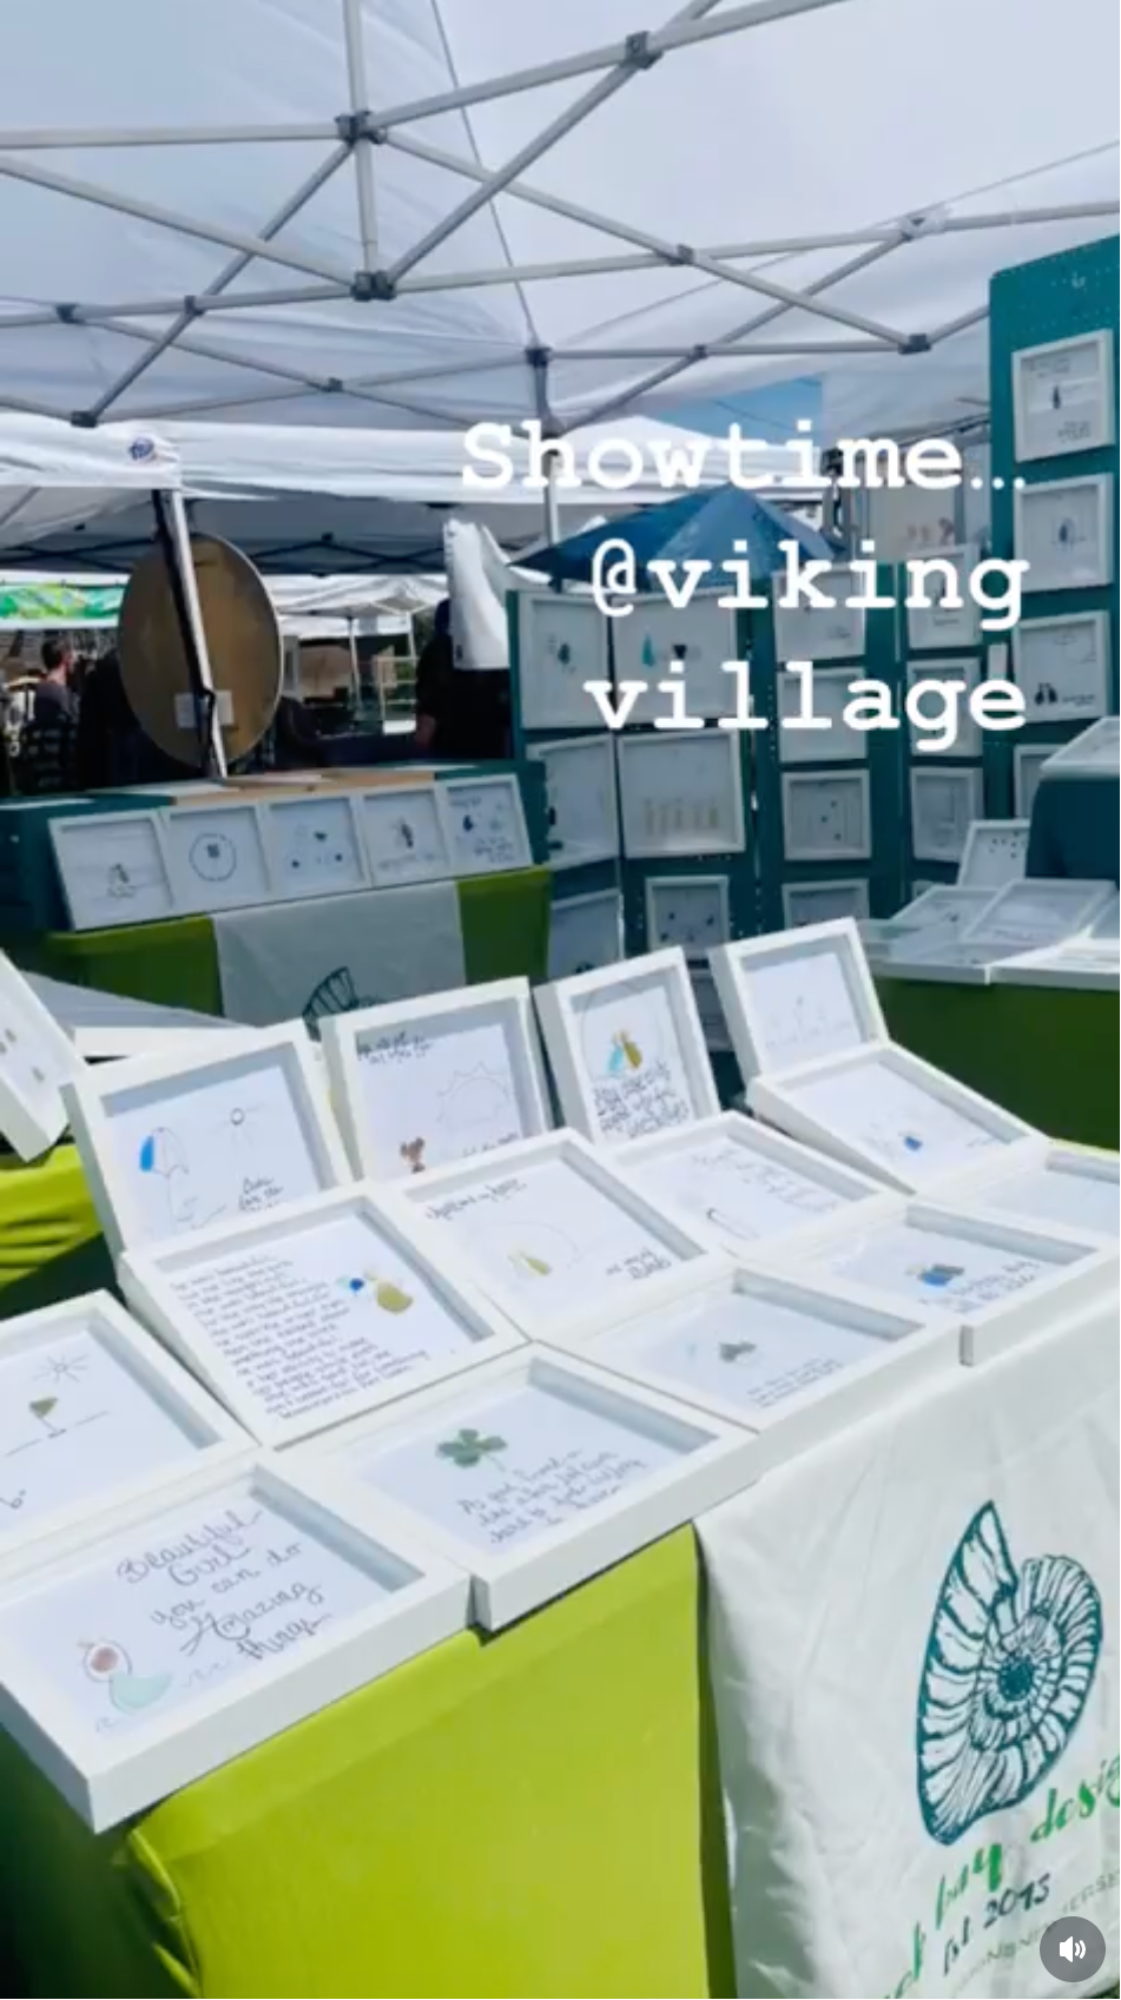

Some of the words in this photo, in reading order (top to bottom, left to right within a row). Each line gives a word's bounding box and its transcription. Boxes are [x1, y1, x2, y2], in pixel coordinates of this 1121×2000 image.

[116, 1509, 263, 1583] Beautiful
[168, 1545, 250, 1587] Girl
[150, 1599, 205, 1630] you
[211, 1569, 260, 1594] can
[267, 1542, 304, 1567] do
[180, 1581, 323, 1656] Amazing
